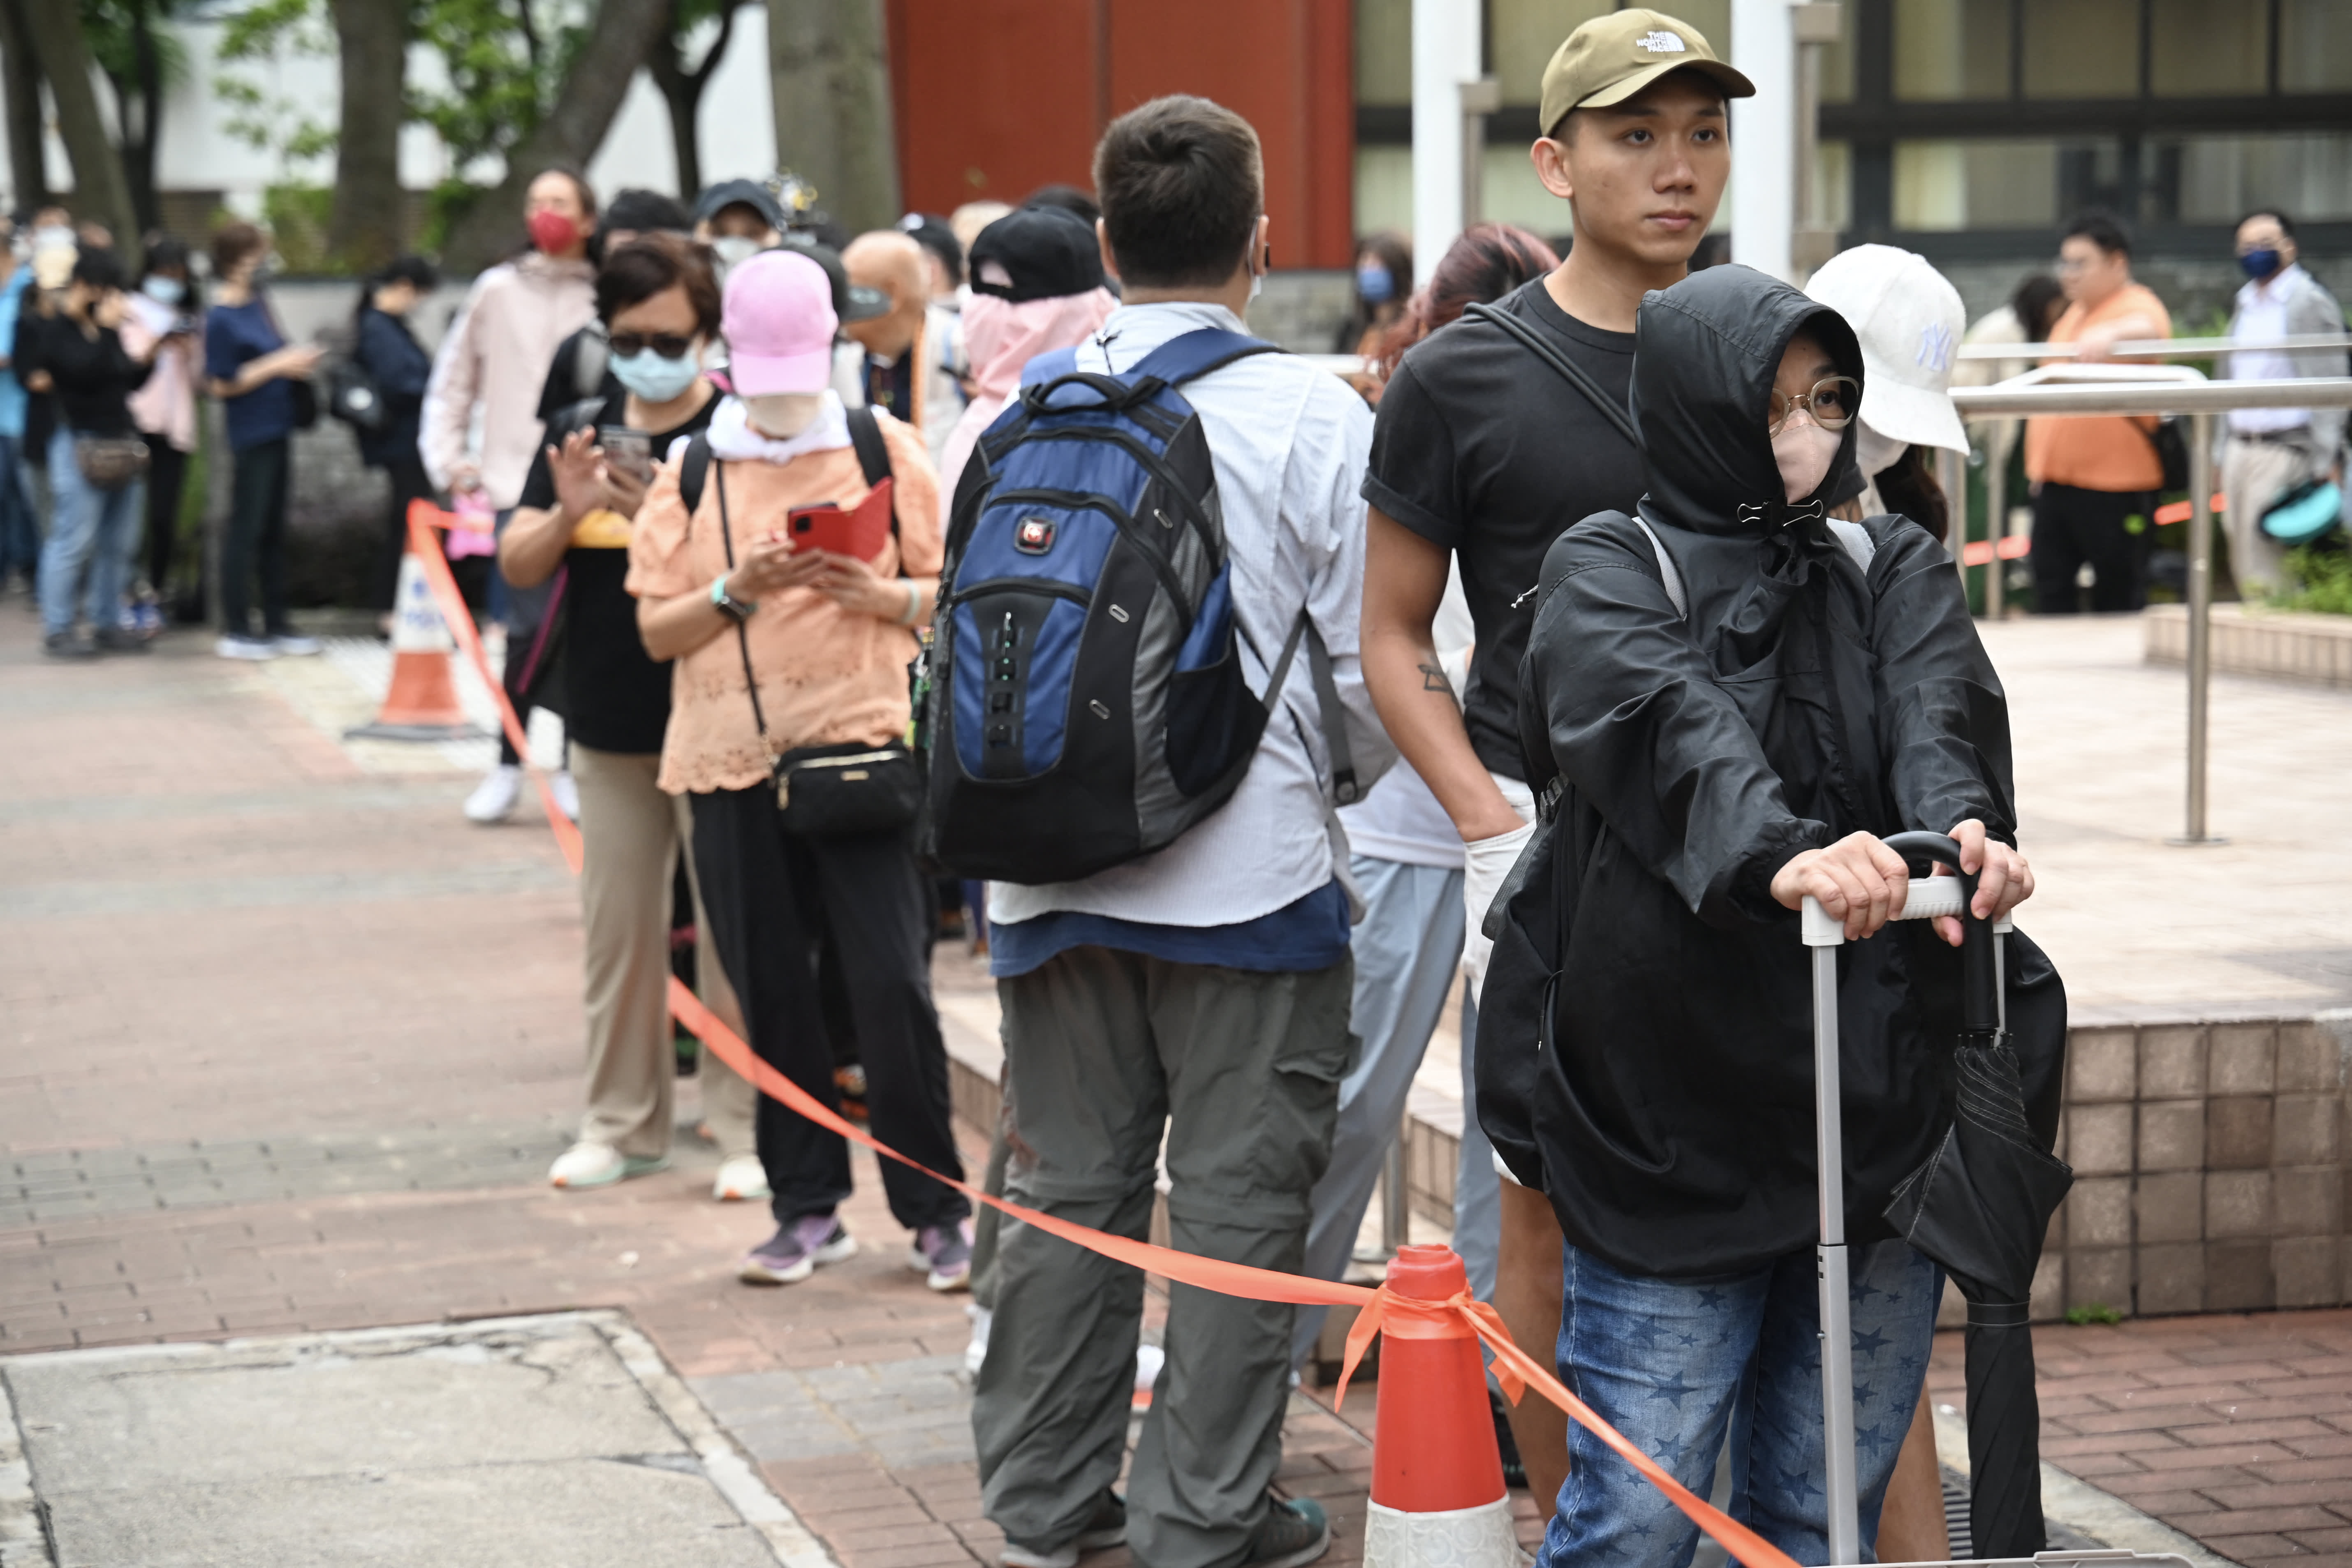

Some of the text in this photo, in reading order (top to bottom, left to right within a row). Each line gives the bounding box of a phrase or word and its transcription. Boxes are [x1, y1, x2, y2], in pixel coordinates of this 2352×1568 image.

[1647, 31, 1665, 40] THE
[1636, 38, 1667, 46] NORTH
[1915, 322, 1952, 371] NY
